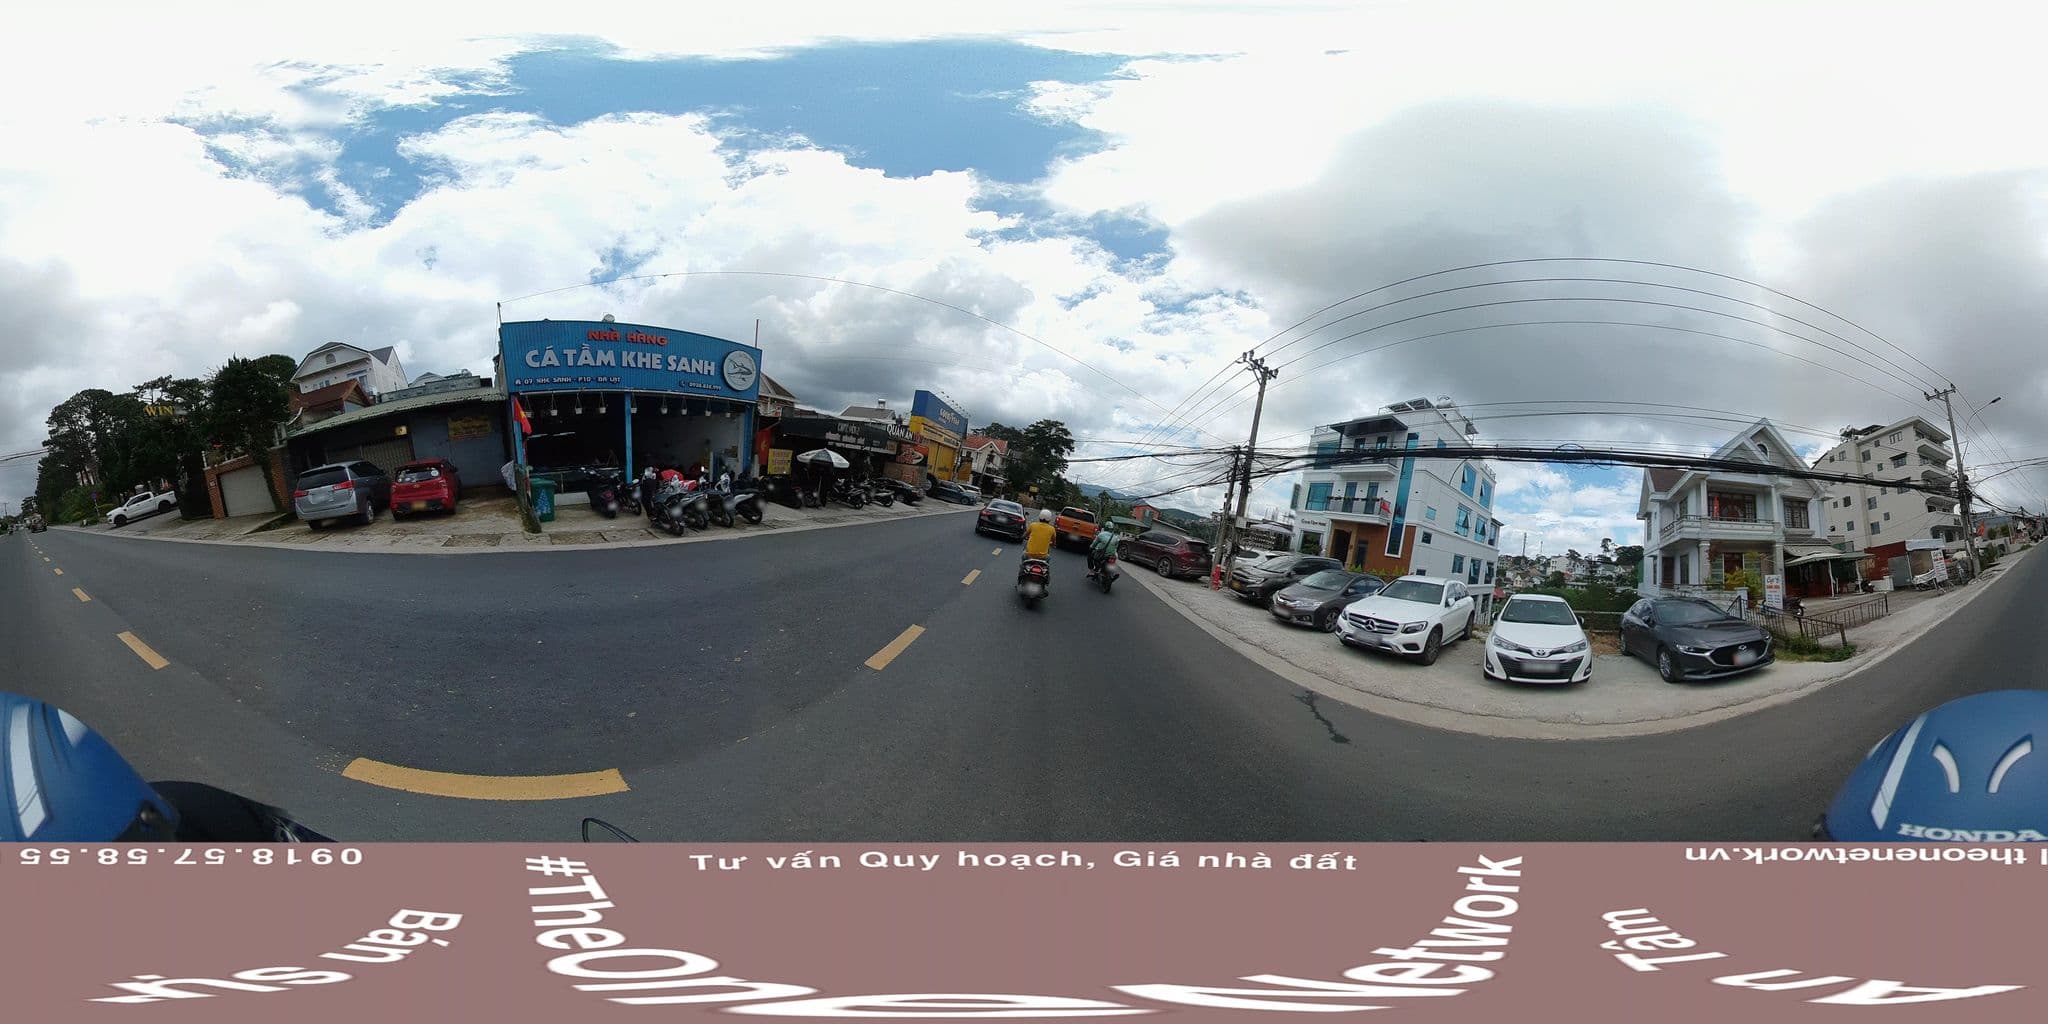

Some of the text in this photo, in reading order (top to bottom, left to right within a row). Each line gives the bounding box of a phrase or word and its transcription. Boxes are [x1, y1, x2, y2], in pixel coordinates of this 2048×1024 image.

[587, 328, 669, 347] NHÀ HÀNG
[525, 343, 716, 376] CÁ TẦM KHE SANH
[1897, 823, 2048, 842] HONDA
